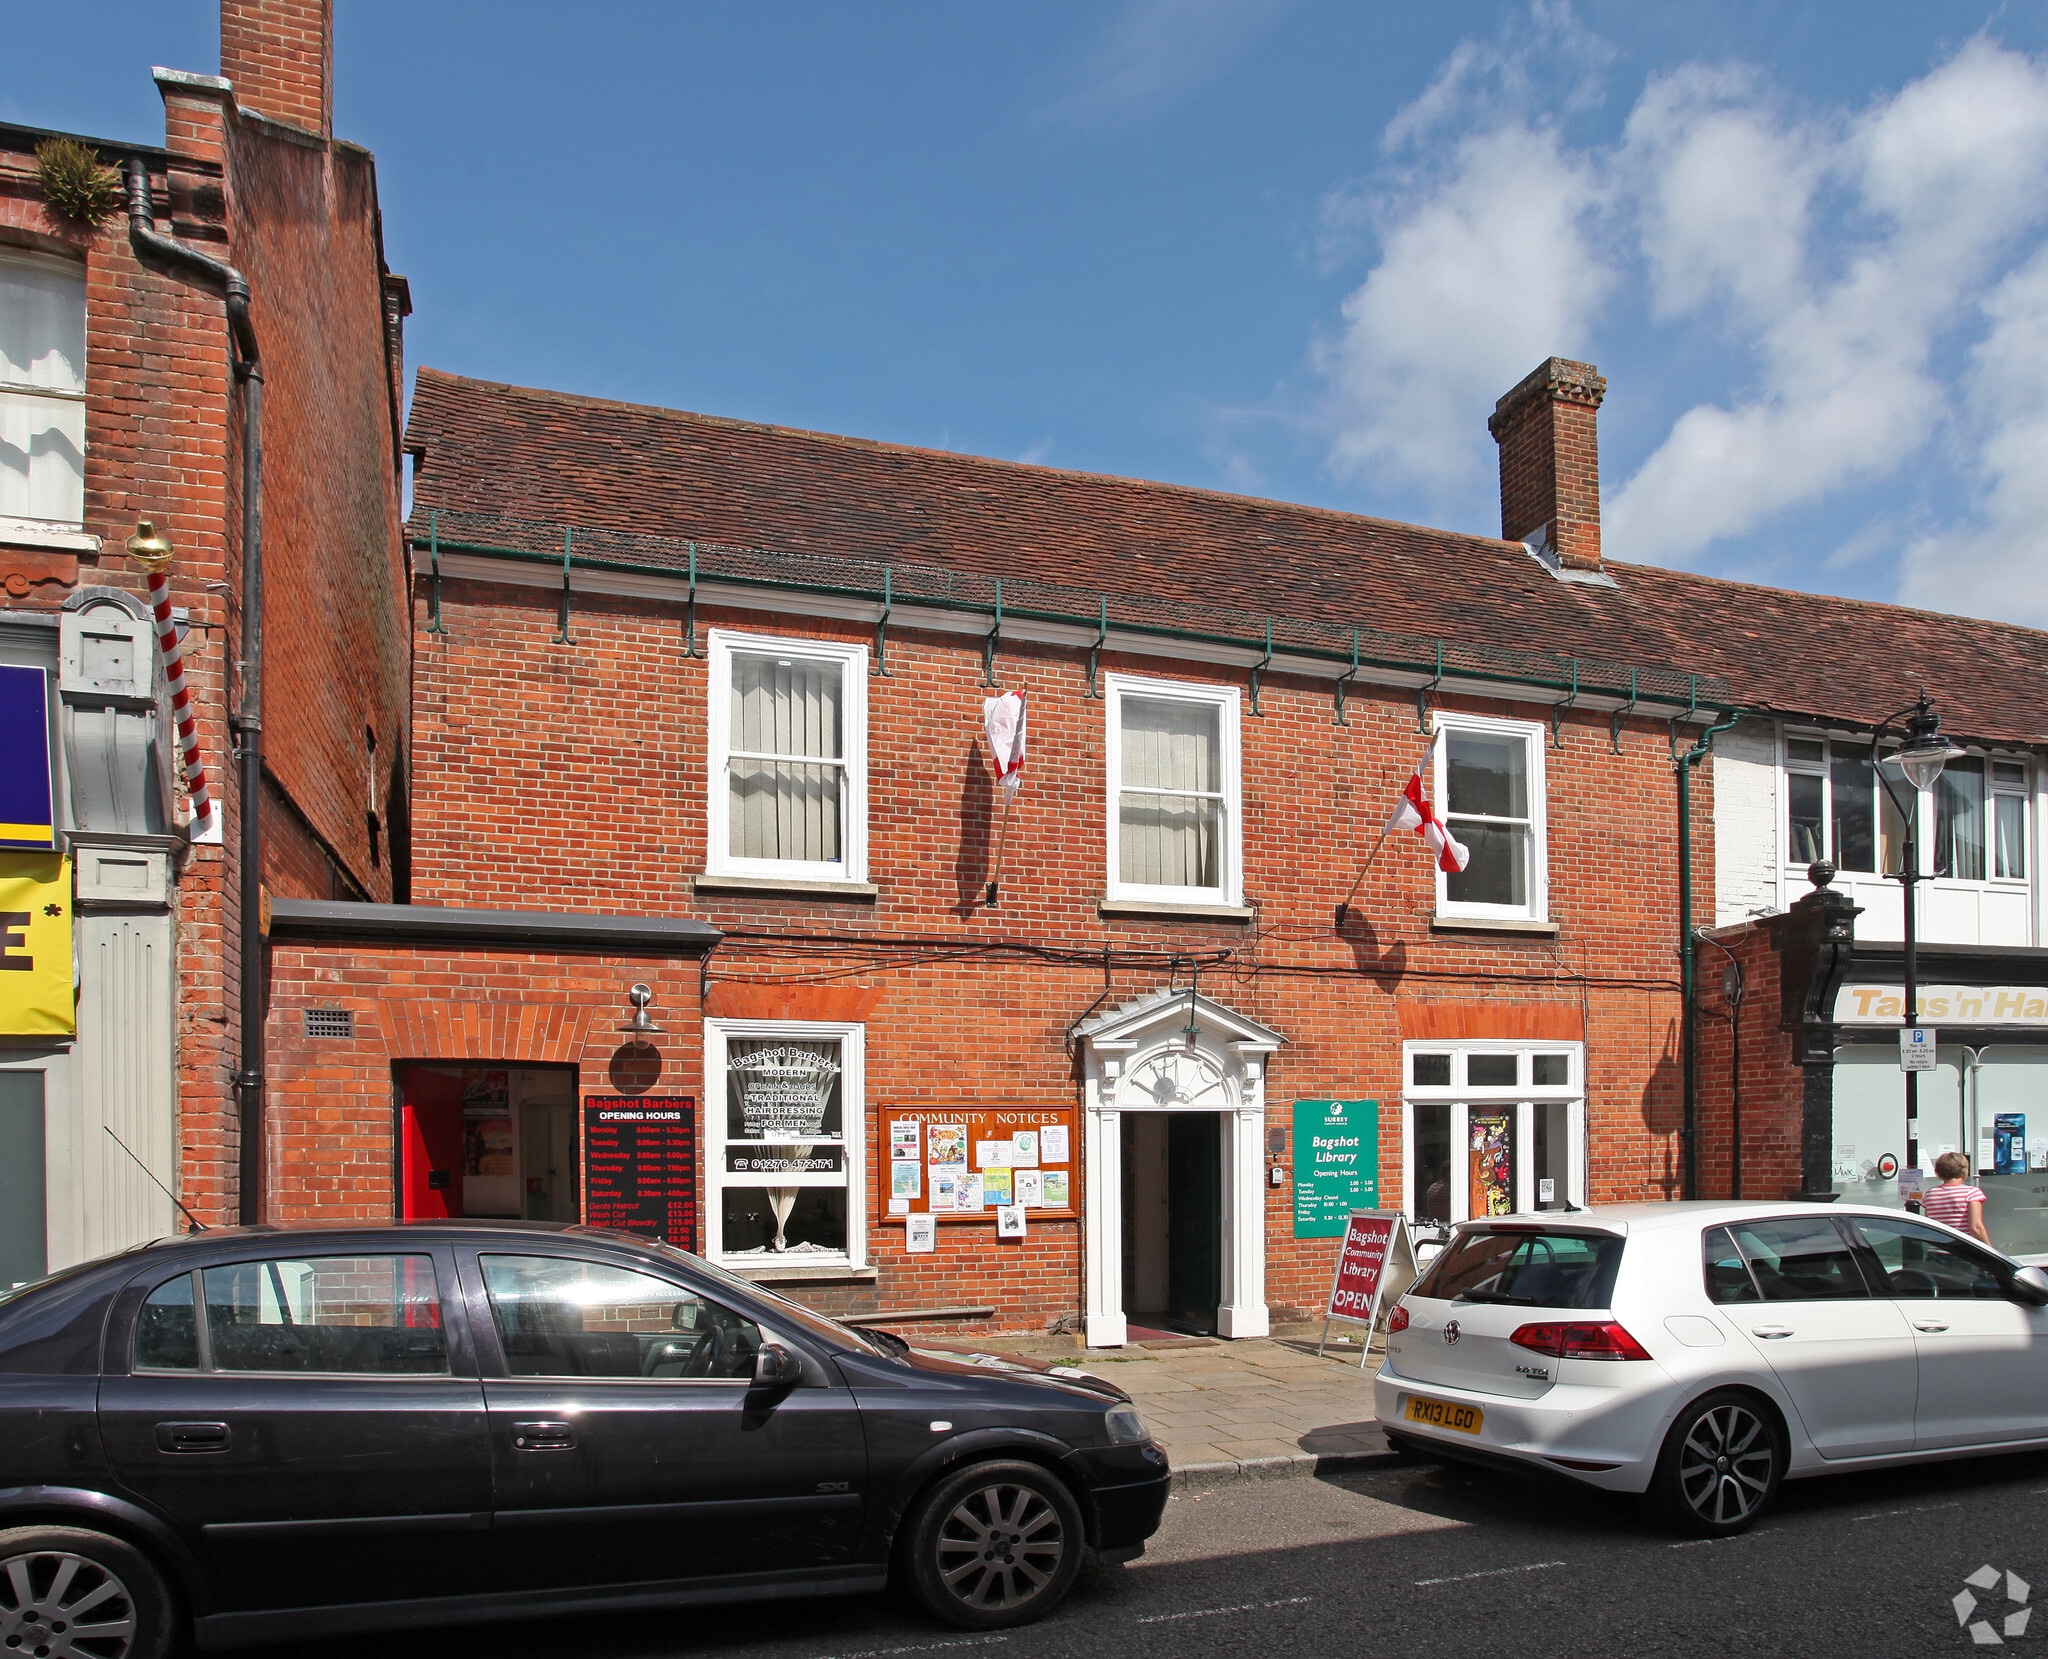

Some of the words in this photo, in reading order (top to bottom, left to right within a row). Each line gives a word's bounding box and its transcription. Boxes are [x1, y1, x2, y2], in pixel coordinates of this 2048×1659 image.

[1956, 991, 1991, 1018] 'n'
[1994, 991, 2048, 1019] Ha
[732, 1046, 786, 1069] Bagshot
[789, 1047, 837, 1072] Barbers
[762, 1068, 807, 1077] MODERN
[780, 1081, 790, 1090] &
[750, 1094, 820, 1102] TRADITIONAL
[586, 1098, 640, 1110] Bagshot
[642, 1098, 693, 1109] Barbers
[599, 1111, 644, 1120] OPENING
[645, 1111, 681, 1120] HOURS
[746, 1107, 823, 1115] HAIRDRESSING
[899, 1112, 987, 1124] COMMUNITY
[996, 1112, 1059, 1124] NOTICES
[761, 1120, 782, 1128] FOR
[784, 1120, 807, 1128] MEN
[589, 1127, 618, 1135] Monday
[589, 1139, 619, 1147] Tuesday
[1312, 1136, 1360, 1150] Bagshot
[590, 1152, 631, 1160] Wednesday
[1315, 1151, 1358, 1165] Library
[751, 1158, 788, 1168] 01276
[792, 1158, 834, 1169] 472171
[1313, 1169, 1339, 1178] Opening
[590, 1177, 613, 1185] Friday
[591, 1190, 622, 1198] Saturday
[588, 1202, 611, 1210] Gents
[612, 1202, 640, 1210] Haircut
[667, 1201, 694, 1209] £12.00
[589, 1219, 610, 1227] Wash
[627, 1219, 658, 1227] Blowdry
[667, 1218, 694, 1226] £15.00
[1349, 1228, 1389, 1246] Bagshot
[1345, 1246, 1384, 1262] Community
[1343, 1261, 1378, 1282] Library
[1334, 1289, 1374, 1312] OPEN
[1413, 1400, 1443, 1423] RX13
[1444, 1406, 1475, 1429] LGO
